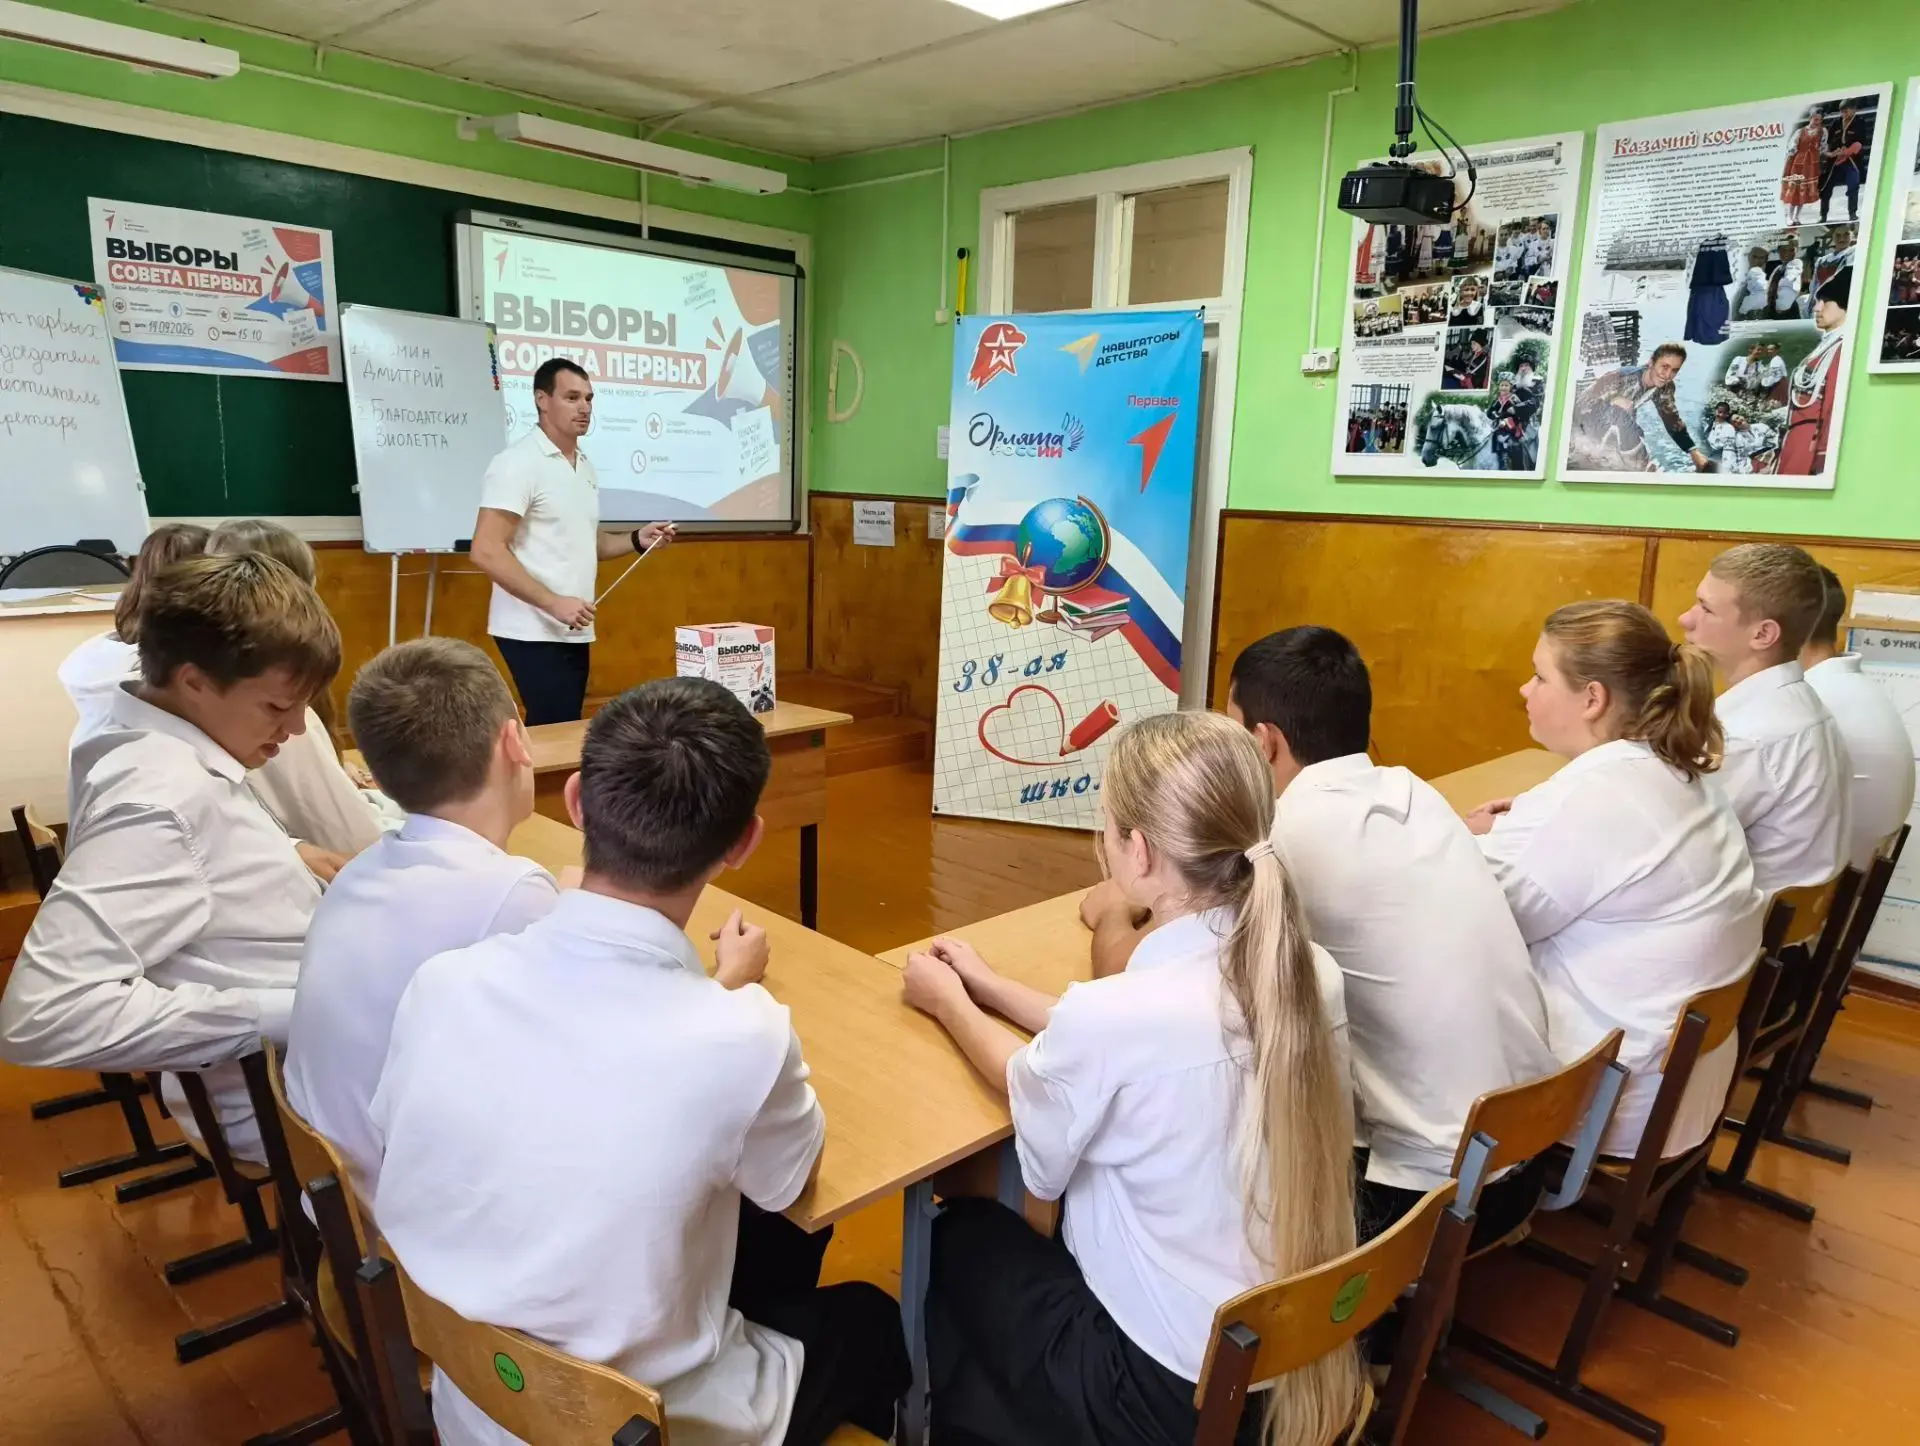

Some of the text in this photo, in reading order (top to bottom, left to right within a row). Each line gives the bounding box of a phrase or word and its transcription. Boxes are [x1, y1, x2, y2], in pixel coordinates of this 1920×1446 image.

[1613, 122, 1783, 156] Казачий костюм
[106, 237, 239, 272] ВЫБОРЫ
[111, 263, 185, 286] СОВЕТА
[186, 271, 260, 294] ПЕРВЫХ
[493, 291, 677, 347] ВЫБОРЫ
[1102, 330, 1180, 354] НАВИГАТОРЫ
[606, 351, 702, 385] ПЕРВЫХ
[1096, 348, 1149, 368] ДЕТСТВА
[363, 360, 444, 388] ДМИТРИЙ
[1127, 394, 1180, 408] Первые
[969, 412, 1064, 452] Орлята
[717, 643, 761, 656] ВЫБОРЫ
[1863, 638, 1875, 647] 4.
[953, 649, 1069, 693] 38-ая
[1020, 773, 1101, 805] шко
